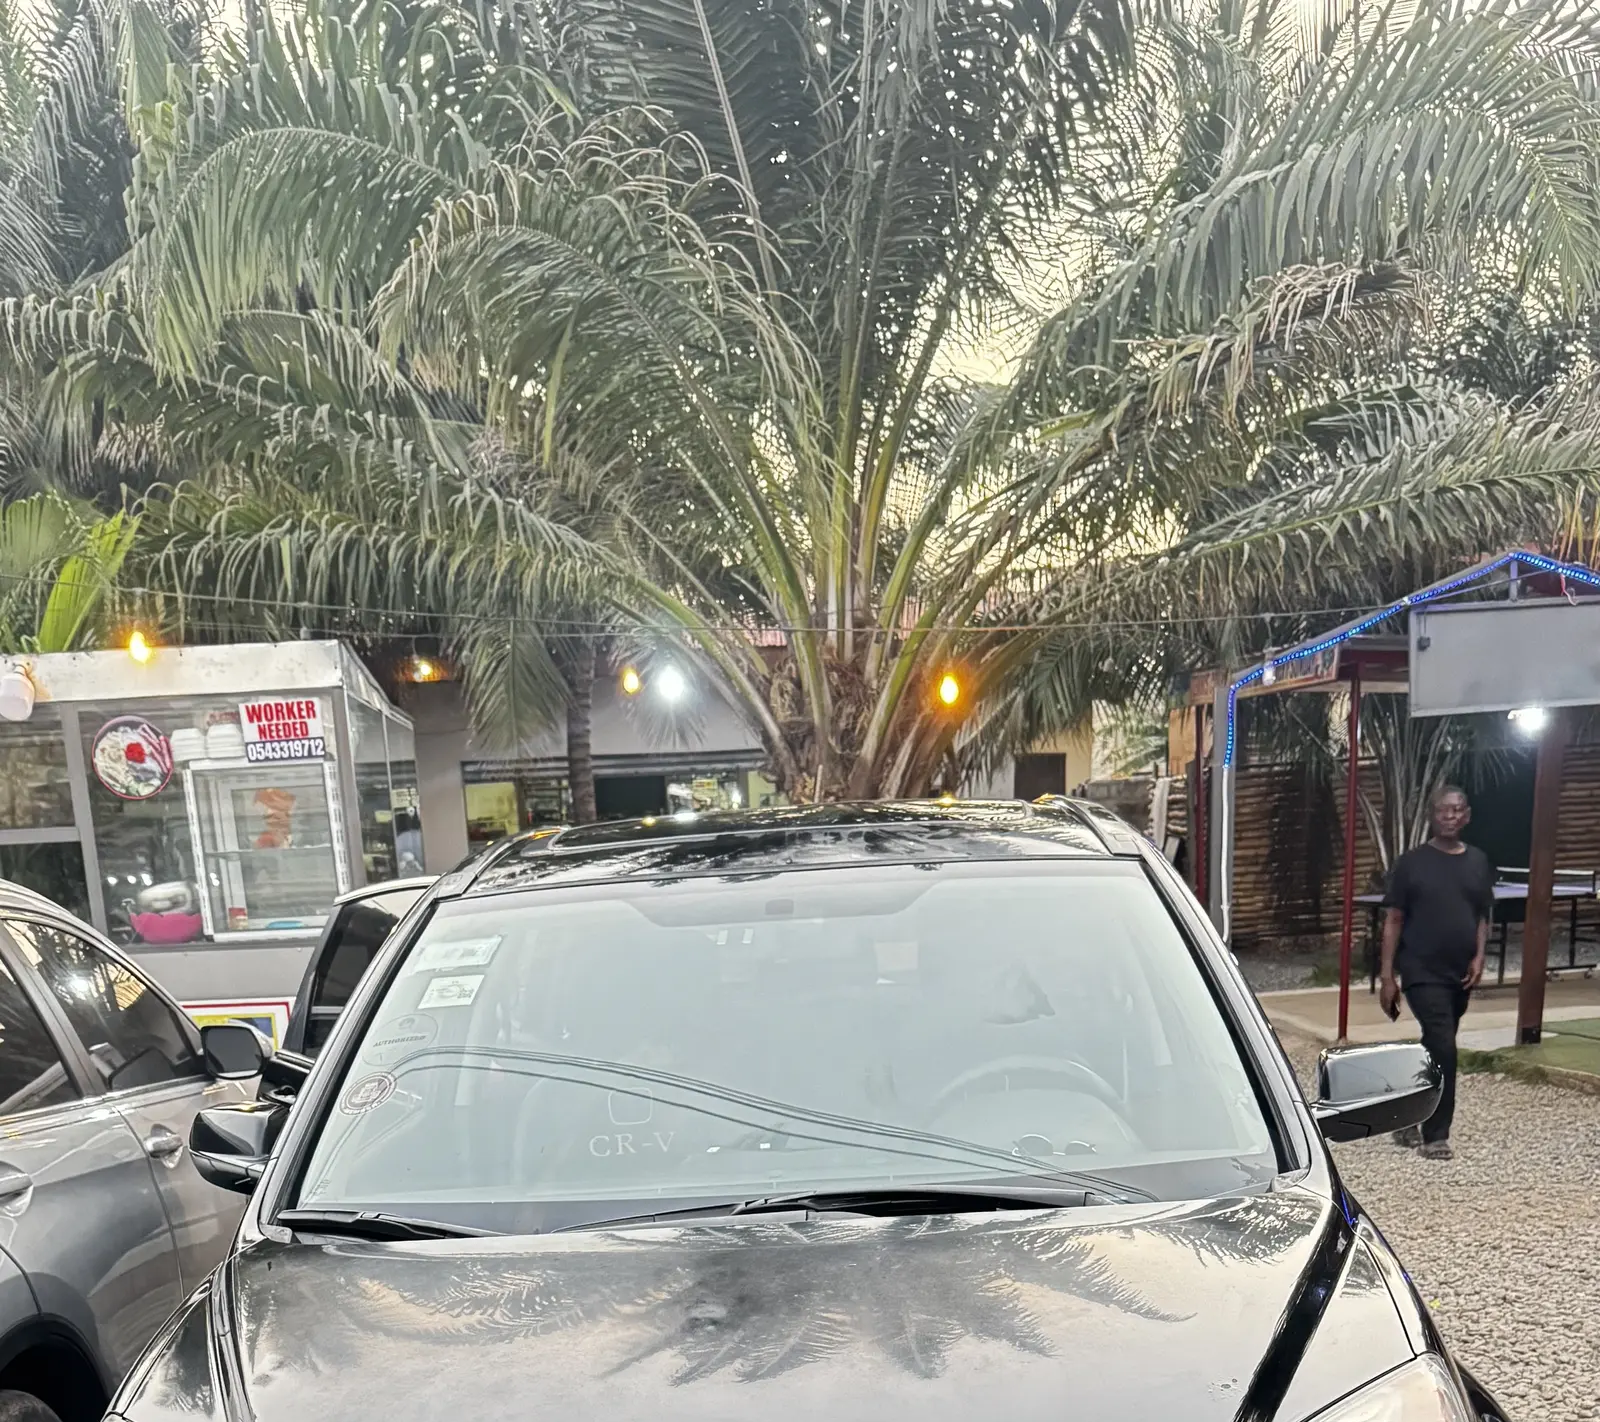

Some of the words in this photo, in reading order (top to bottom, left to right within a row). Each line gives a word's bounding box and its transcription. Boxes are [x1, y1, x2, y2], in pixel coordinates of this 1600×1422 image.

[245, 700, 316, 723] WORKER
[257, 721, 309, 740] NEEDED
[247, 738, 325, 761] 0543319712
[589, 1131, 676, 1157] CR-V
